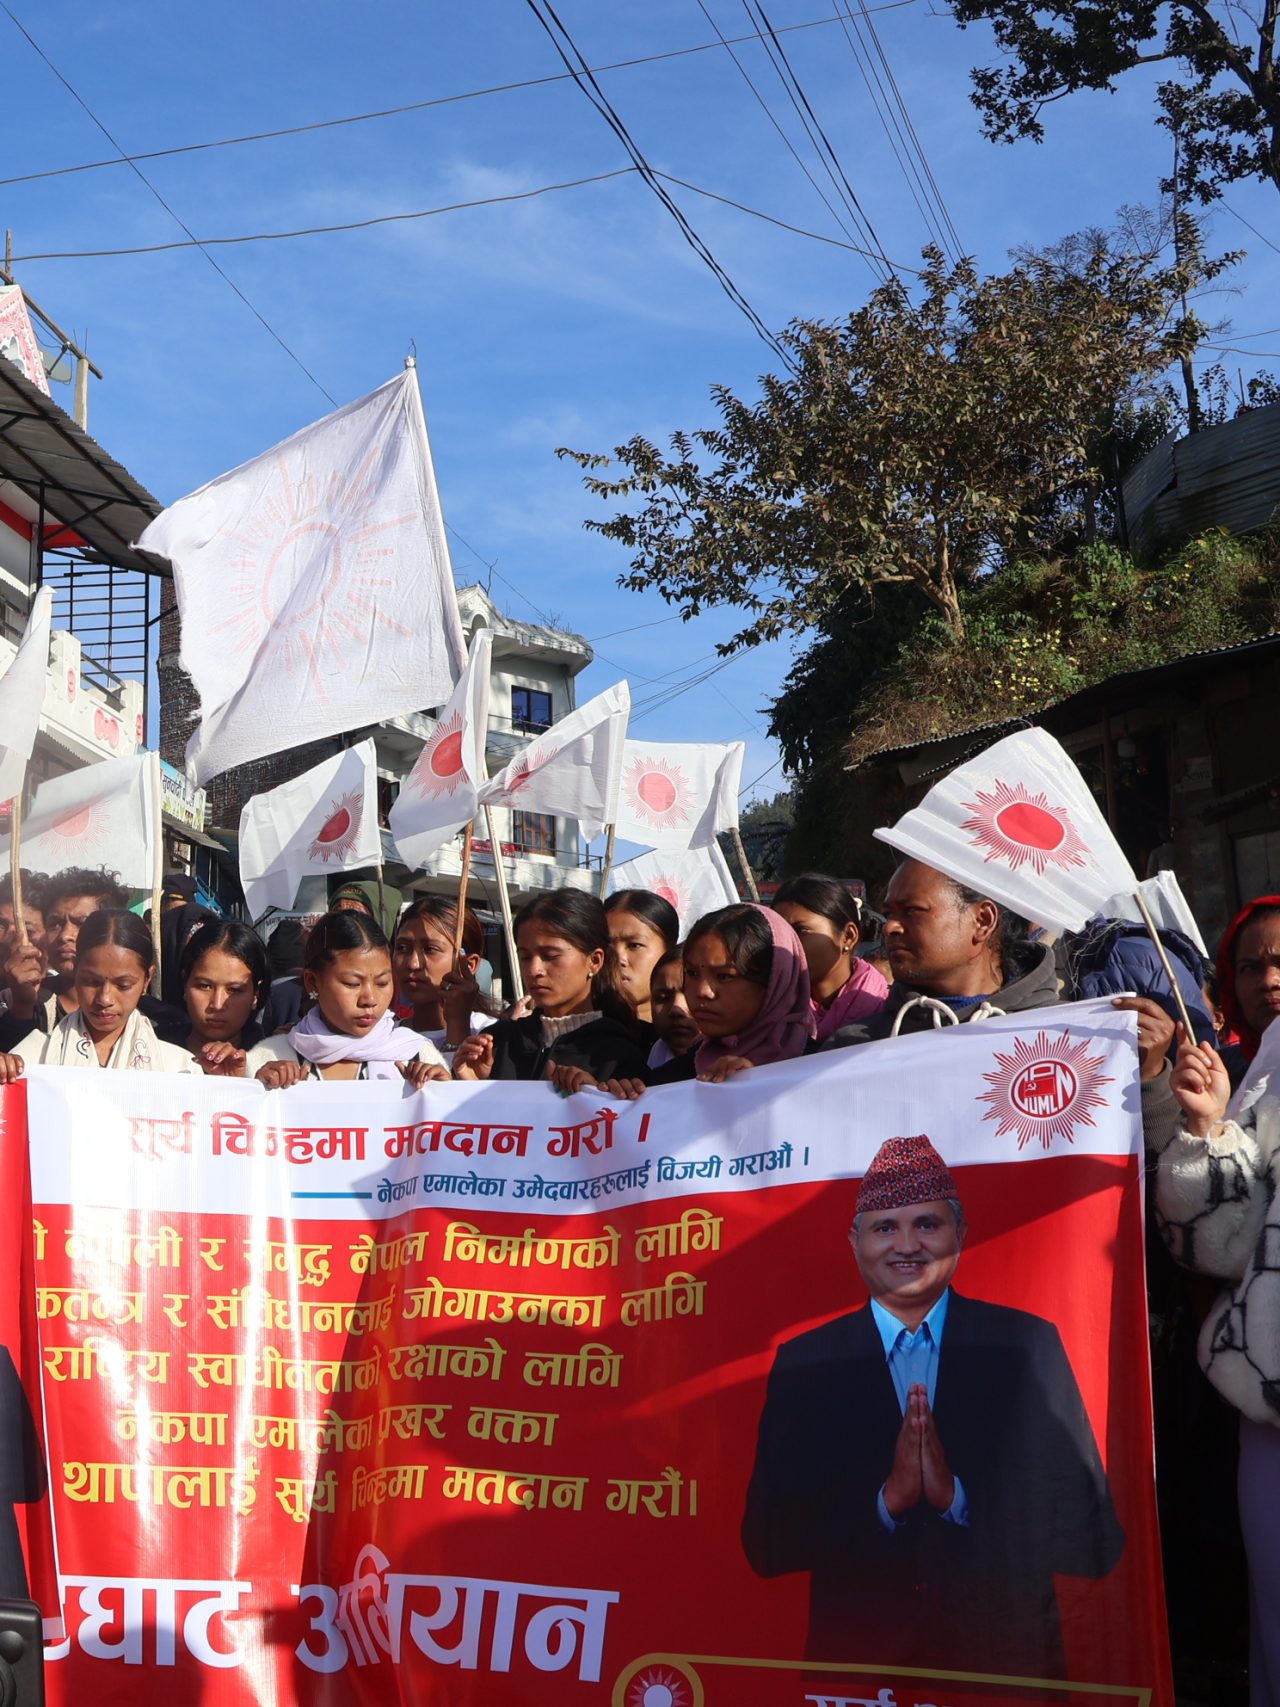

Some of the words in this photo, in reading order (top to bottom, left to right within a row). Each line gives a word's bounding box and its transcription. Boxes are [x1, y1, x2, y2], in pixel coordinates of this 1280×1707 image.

[384, 1120, 533, 1158] मतदान
[377, 1178, 417, 1204] नेकपा
[423, 1170, 506, 1198] एमालेका
[657, 1155, 722, 1183] विजयी
[200, 1238, 226, 1271] र
[349, 1231, 429, 1275] नेपाल
[443, 1221, 621, 1270] निर्माणको
[635, 1208, 724, 1263] लागि
[163, 1293, 190, 1327] र
[402, 1276, 606, 1328] जोगाउनका
[620, 1271, 708, 1327] लागि
[387, 1337, 508, 1381] रक्षाको
[522, 1342, 625, 1388] लागि
[466, 1405, 560, 1447] वक्ता
[275, 1470, 339, 1523] सूर्य
[442, 1465, 589, 1512] मतदान
[43, 1574, 253, 1669] घाट
